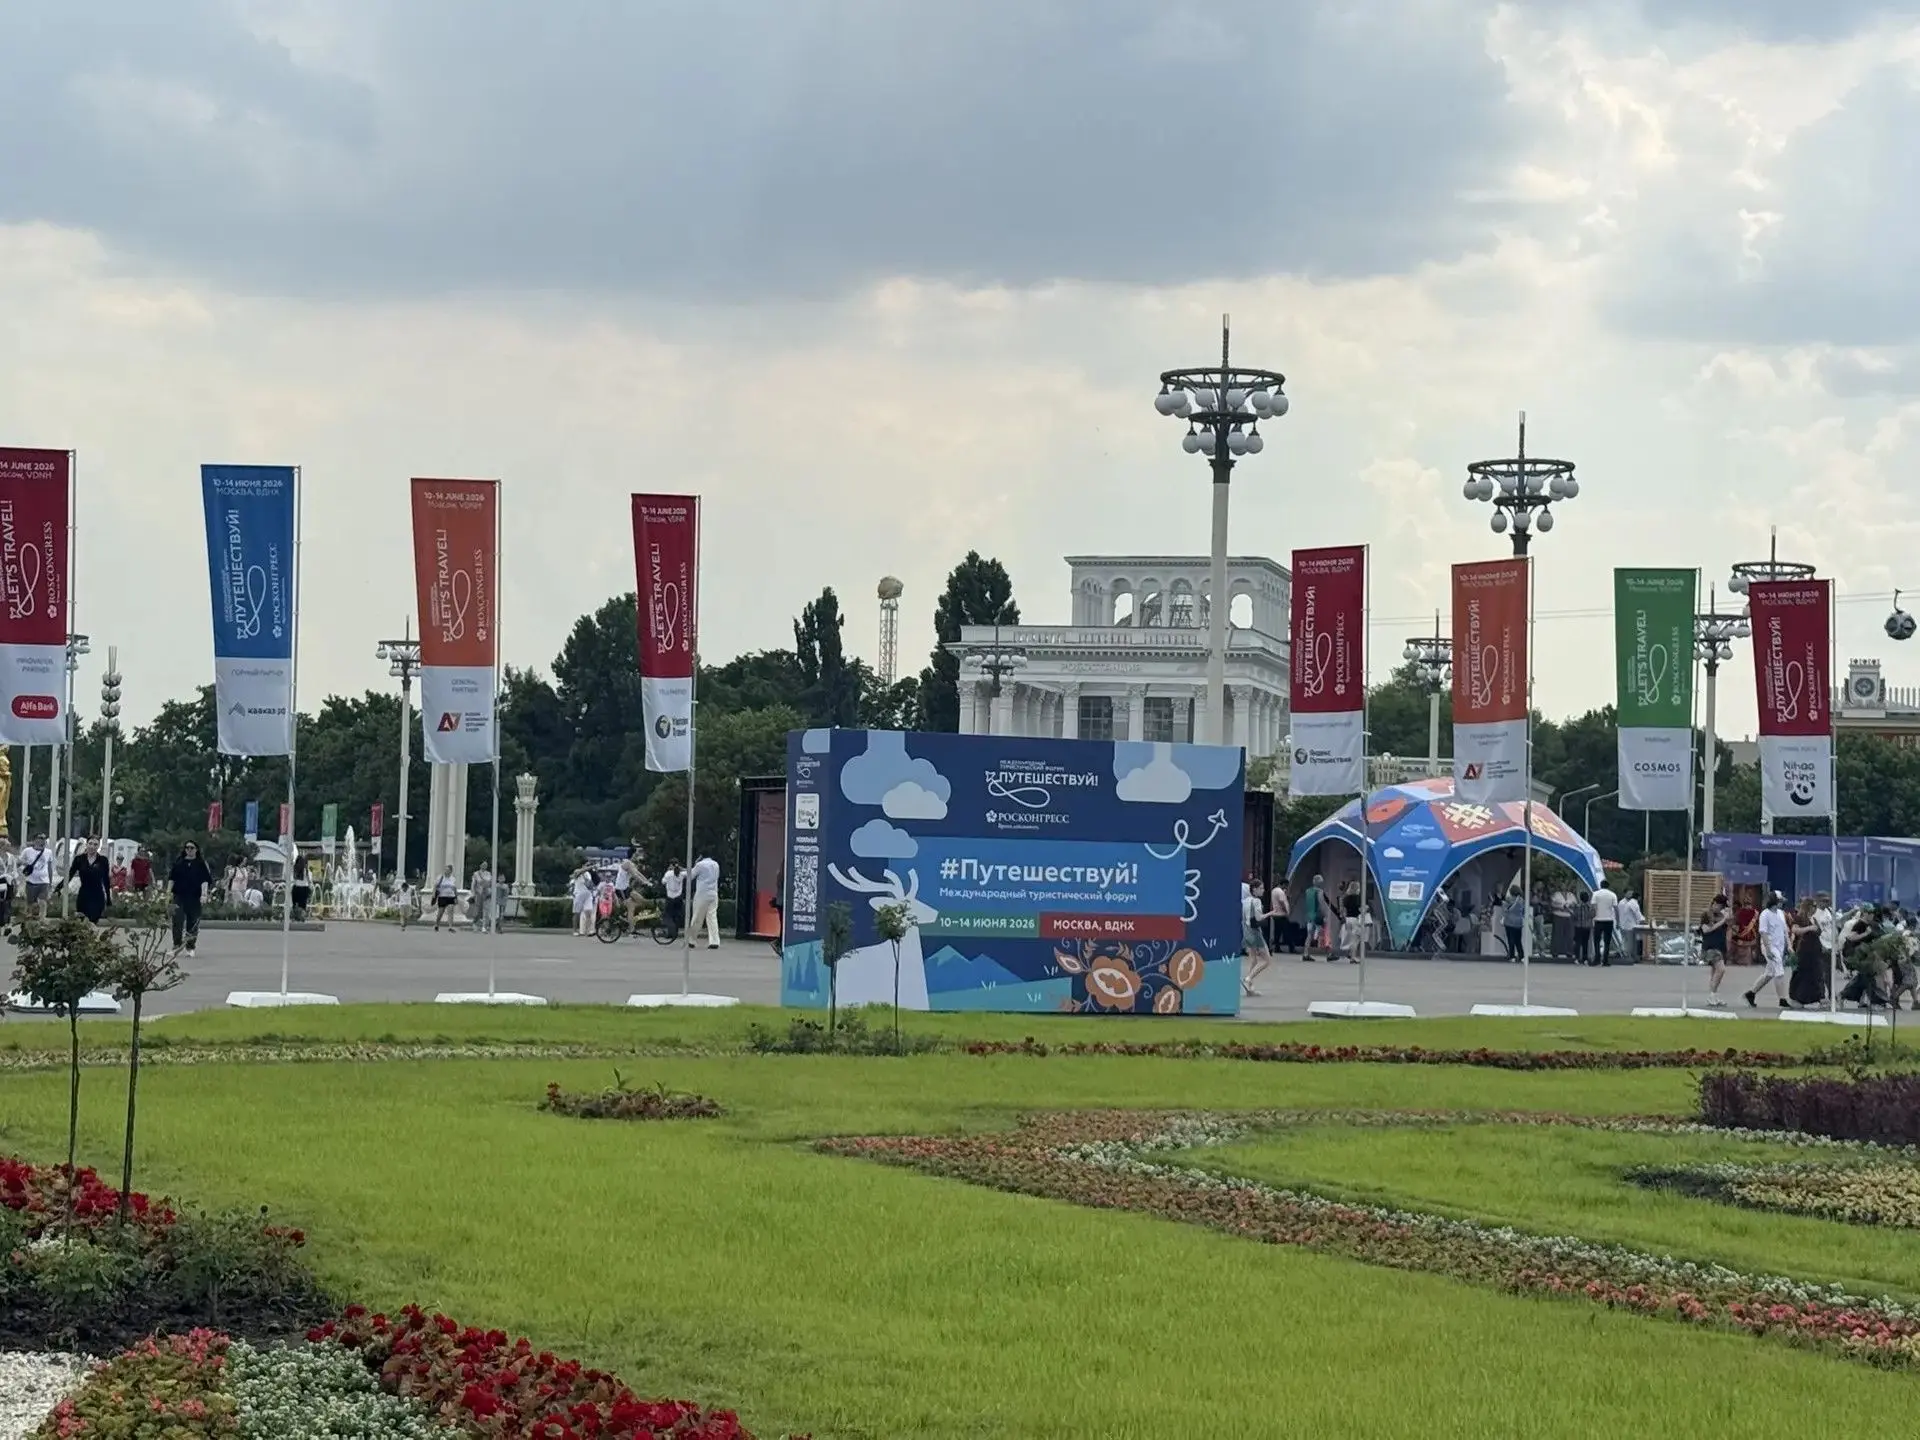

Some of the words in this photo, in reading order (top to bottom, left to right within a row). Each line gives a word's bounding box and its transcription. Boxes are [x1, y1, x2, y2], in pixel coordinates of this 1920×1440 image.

[12, 462, 32, 471] JUNE
[34, 463, 55, 471] 2026
[235, 479, 261, 488] ИЮНЯ
[263, 480, 283, 488] 2026
[0, 500, 16, 561] TRAVEL!
[43, 520, 56, 604] ROSCONGRESS
[226, 509, 246, 624] ПУТЕШЕСТВУЙ!
[436, 529, 449, 586] TRAVEL!
[651, 543, 662, 600] TRAVEL!
[269, 543, 281, 624] РОСКОНГРЕСС
[1304, 586, 1316, 683] ПУТЕШЕСТВУЙ!
[1636, 610, 1647, 660] TRAVEL!
[1468, 599, 1481, 697] ПУТЕШЕСТВУЙ!
[1768, 617, 1786, 709] ПУТЕШЕСТВУЙ!
[20, 701, 37, 710] Alfa
[1634, 762, 1681, 773] COSMOS
[1783, 760, 1815, 770] Nihao
[1784, 770, 1816, 781] China
[999, 771, 1099, 787] ПУТЕШЕСТВУЙ!
[998, 812, 1070, 824] РОСКОНГРЕСС
[939, 858, 1138, 889] #Путешествуй!
[939, 888, 1027, 900] Международный
[1028, 890, 1103, 901] туристический
[1104, 891, 1137, 903] форум
[972, 918, 1007, 929] ИЮНЯ
[1009, 918, 1035, 929] 2026
[1053, 919, 1102, 932] МОСКВА,
[1105, 920, 1135, 932] ВДНХ
